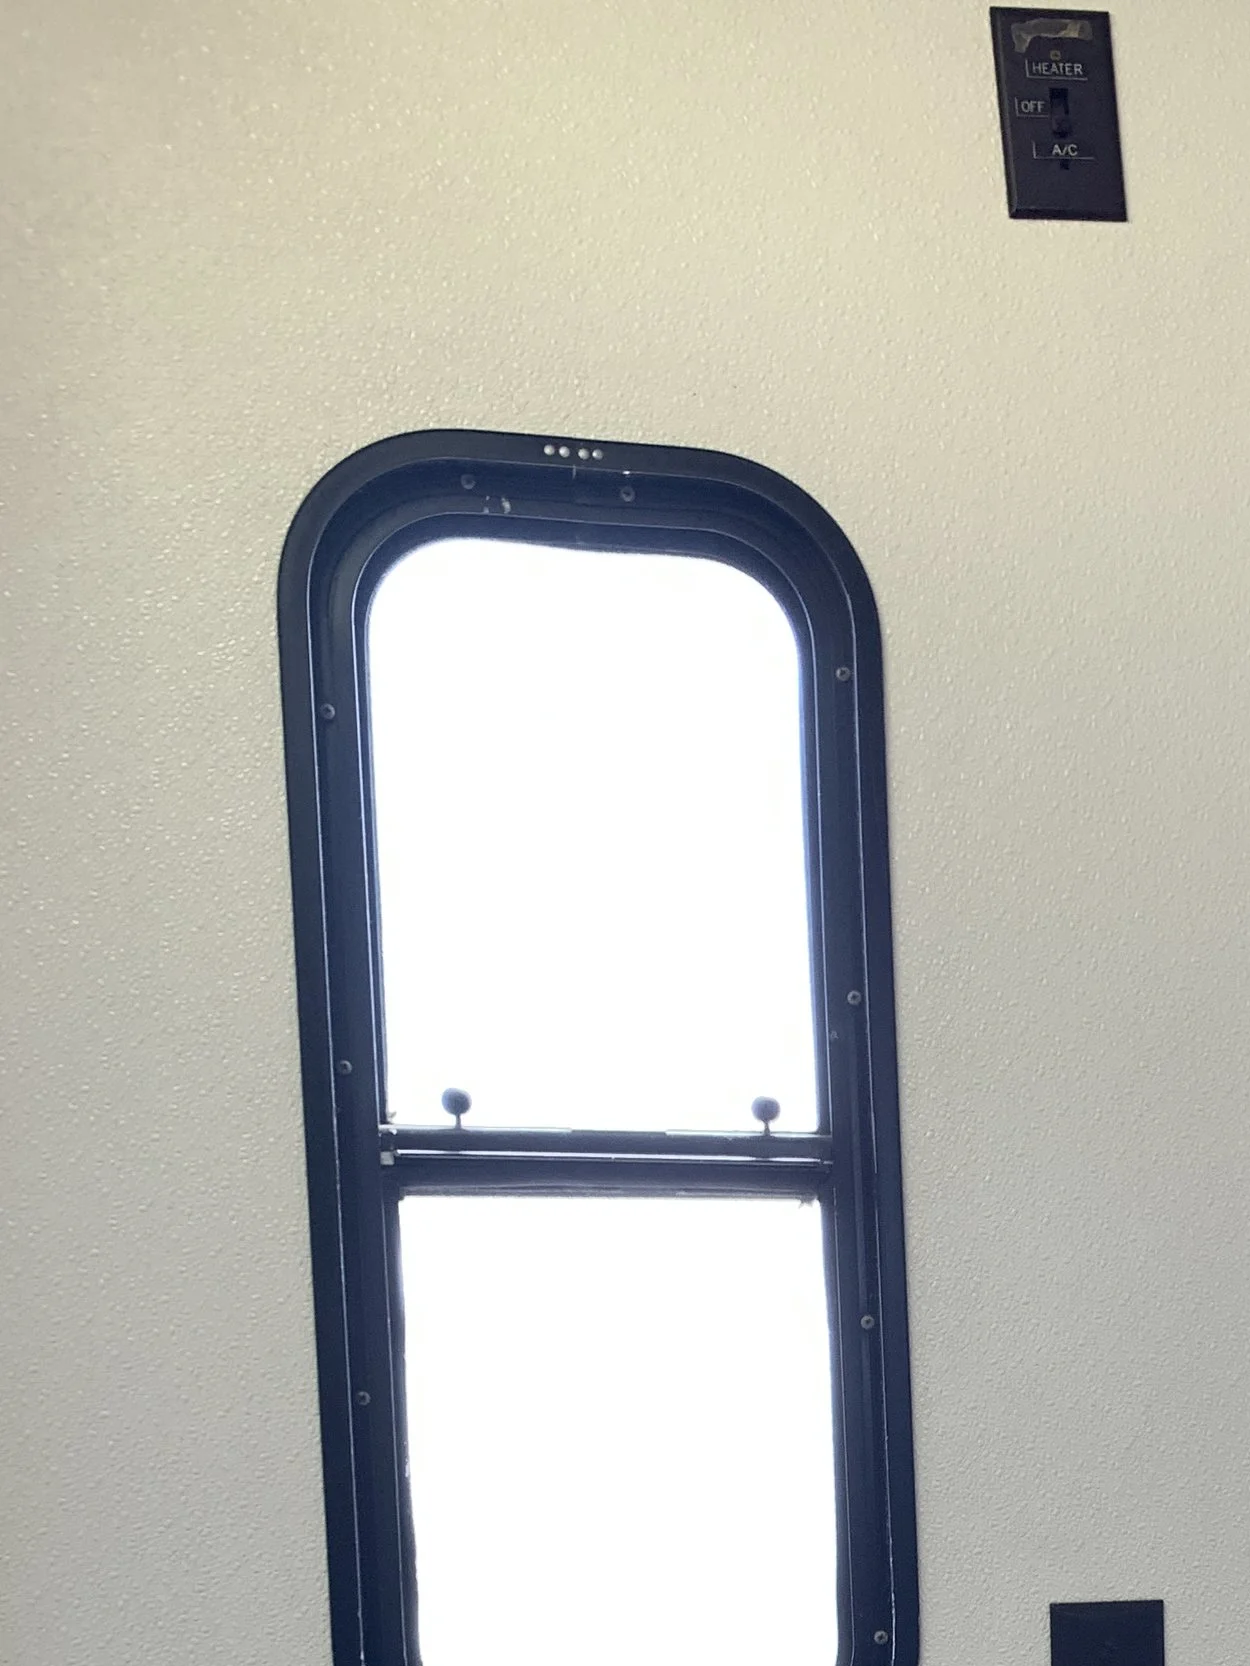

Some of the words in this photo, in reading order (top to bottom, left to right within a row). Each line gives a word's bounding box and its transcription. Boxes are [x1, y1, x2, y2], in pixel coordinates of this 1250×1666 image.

[1032, 62, 1084, 76] HEATER
[1021, 100, 1045, 113] OFF
[1052, 143, 1078, 156] A/C
